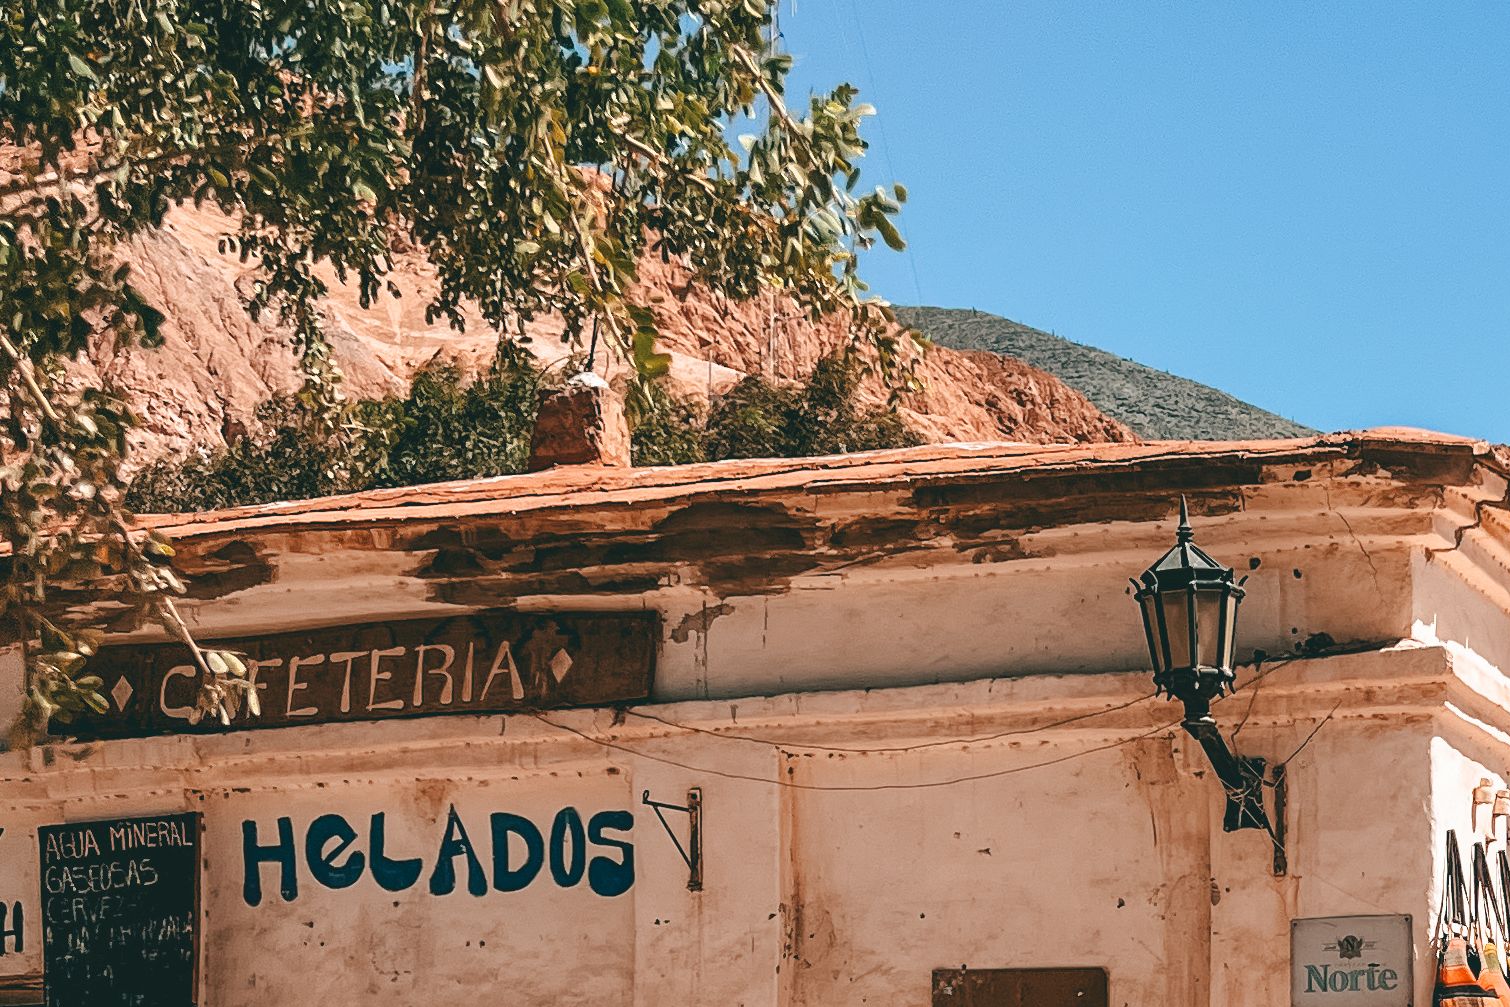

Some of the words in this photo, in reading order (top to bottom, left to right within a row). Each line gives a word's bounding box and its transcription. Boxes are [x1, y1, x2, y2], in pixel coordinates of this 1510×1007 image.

[46, 829, 101, 864] AGUA
[45, 858, 159, 894] GASEOSAS
[1304, 963, 1398, 993] Norte
